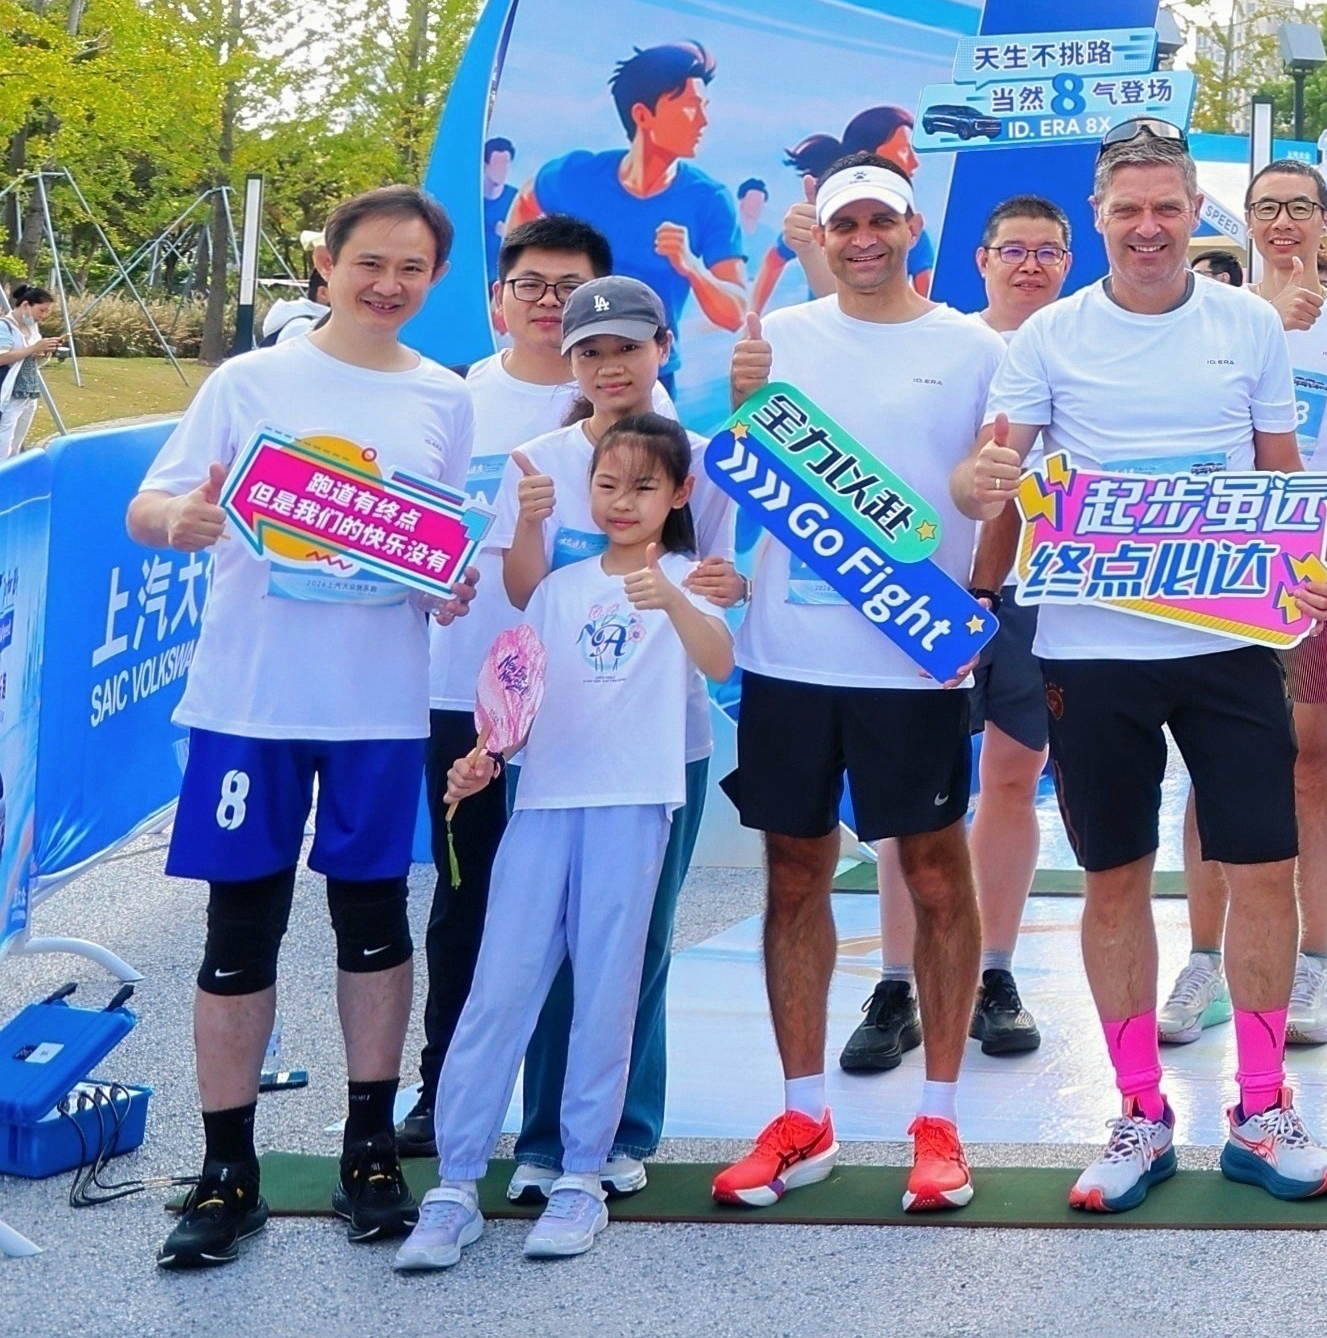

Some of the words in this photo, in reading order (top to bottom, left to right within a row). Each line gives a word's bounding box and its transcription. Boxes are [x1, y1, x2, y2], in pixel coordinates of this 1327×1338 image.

[974, 40, 1113, 72] 天生不挑路
[990, 72, 1173, 117] 当然8气登场
[1008, 120, 1035, 138] ID.
[1041, 118, 1081, 136] ERA
[1086, 116, 1112, 134] 8X
[1205, 205, 1239, 235] SPEED
[594, 295, 610, 312] LA
[750, 394, 915, 542] 全力以赴
[246, 480, 452, 574] 但是我们的快乐没有
[305, 471, 423, 533] 跑道有终点
[787, 501, 845, 558] Go
[839, 545, 953, 654] Fight
[1023, 540, 1278, 600] 终点必达
[90, 670, 130, 728] SAIC
[133, 638, 199, 701] VOLKSWA
[216, 769, 250, 831] 8
